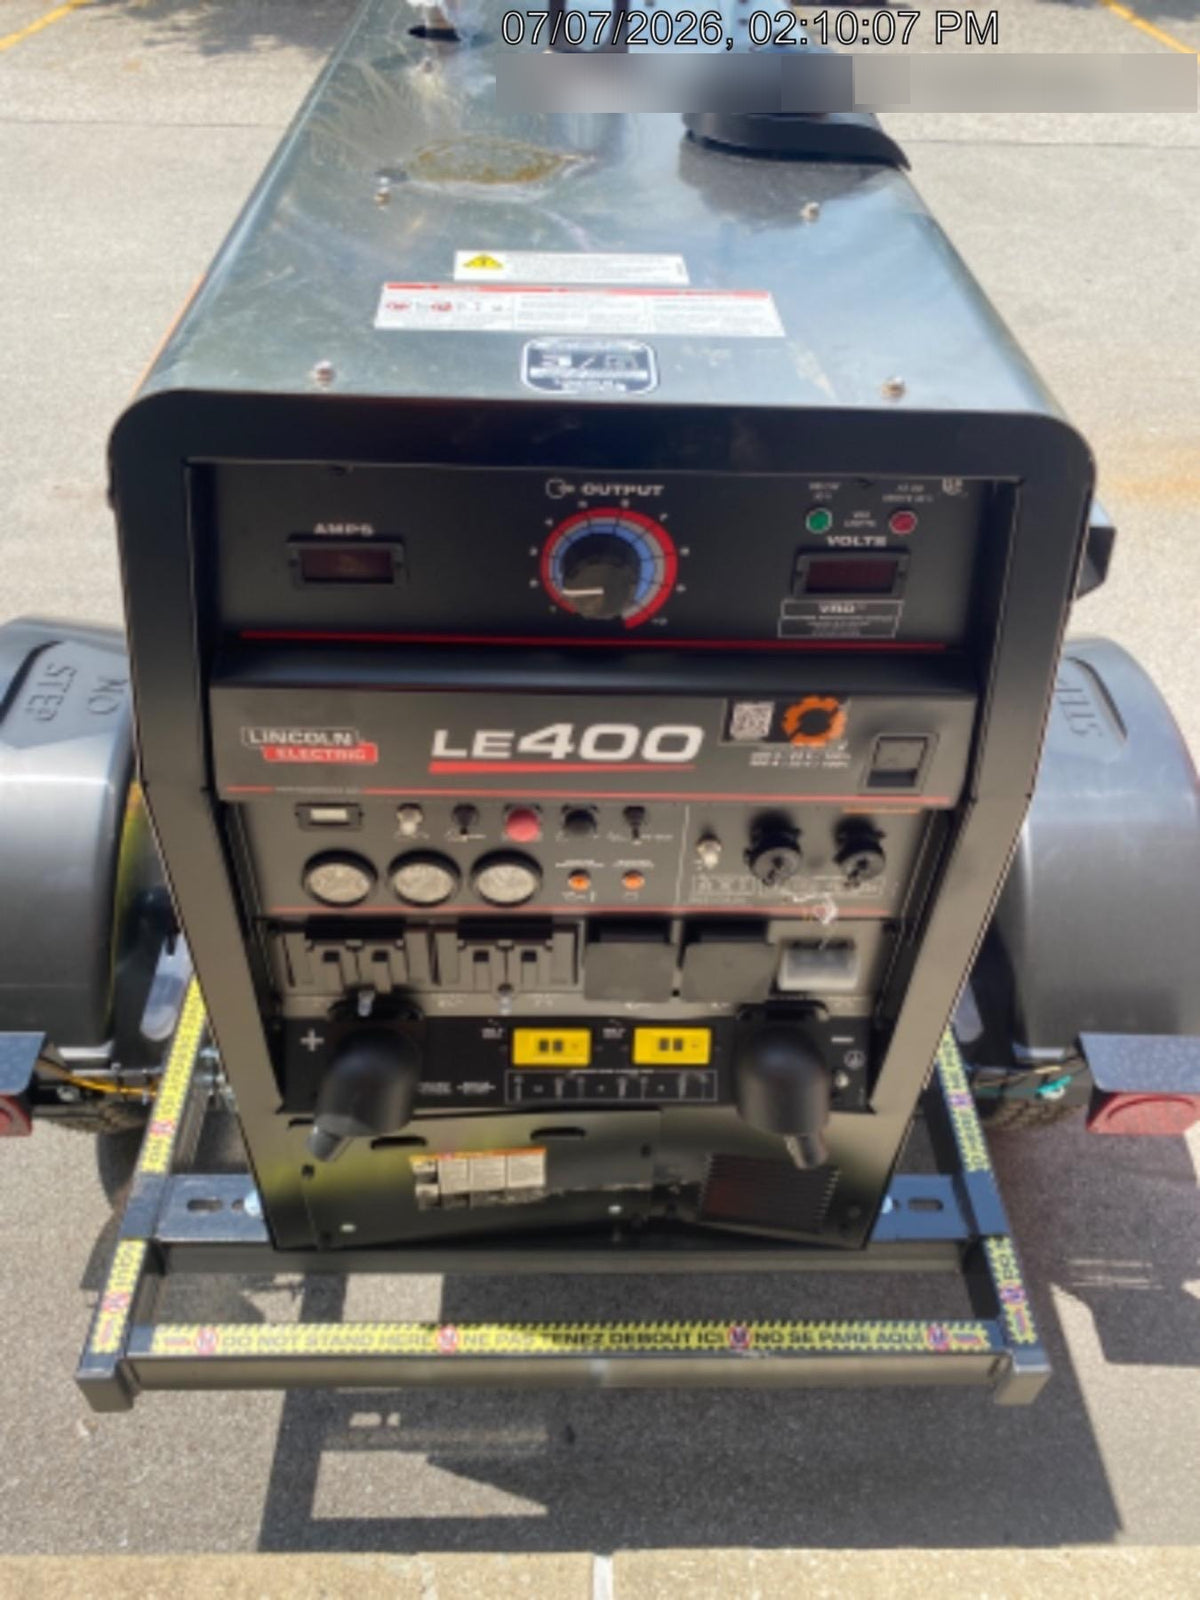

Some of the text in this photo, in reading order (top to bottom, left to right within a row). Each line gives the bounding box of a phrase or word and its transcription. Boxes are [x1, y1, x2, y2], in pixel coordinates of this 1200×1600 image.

[581, 484, 664, 496] OUTPUT
[313, 523, 374, 536] AMPS
[827, 535, 887, 547] VOLTS
[24, 662, 77, 722] STEP
[87, 676, 129, 715] NO
[250, 730, 352, 745] LINCOLN
[431, 723, 704, 763] LE400
[275, 748, 366, 760] ELECTRIC
[258, 1334, 297, 1346] NOT
[306, 1333, 373, 1347] STAND
[380, 1333, 432, 1347] HERE
[463, 1333, 491, 1346] NE
[496, 1333, 536, 1346] PAS
[539, 1332, 603, 1346] TENEZ
[608, 1332, 692, 1345] DEBOUT
[697, 1332, 725, 1345] ICI
[754, 1332, 784, 1344] NO
[790, 1332, 812, 1344] SE
[818, 1332, 869, 1344] PARE
